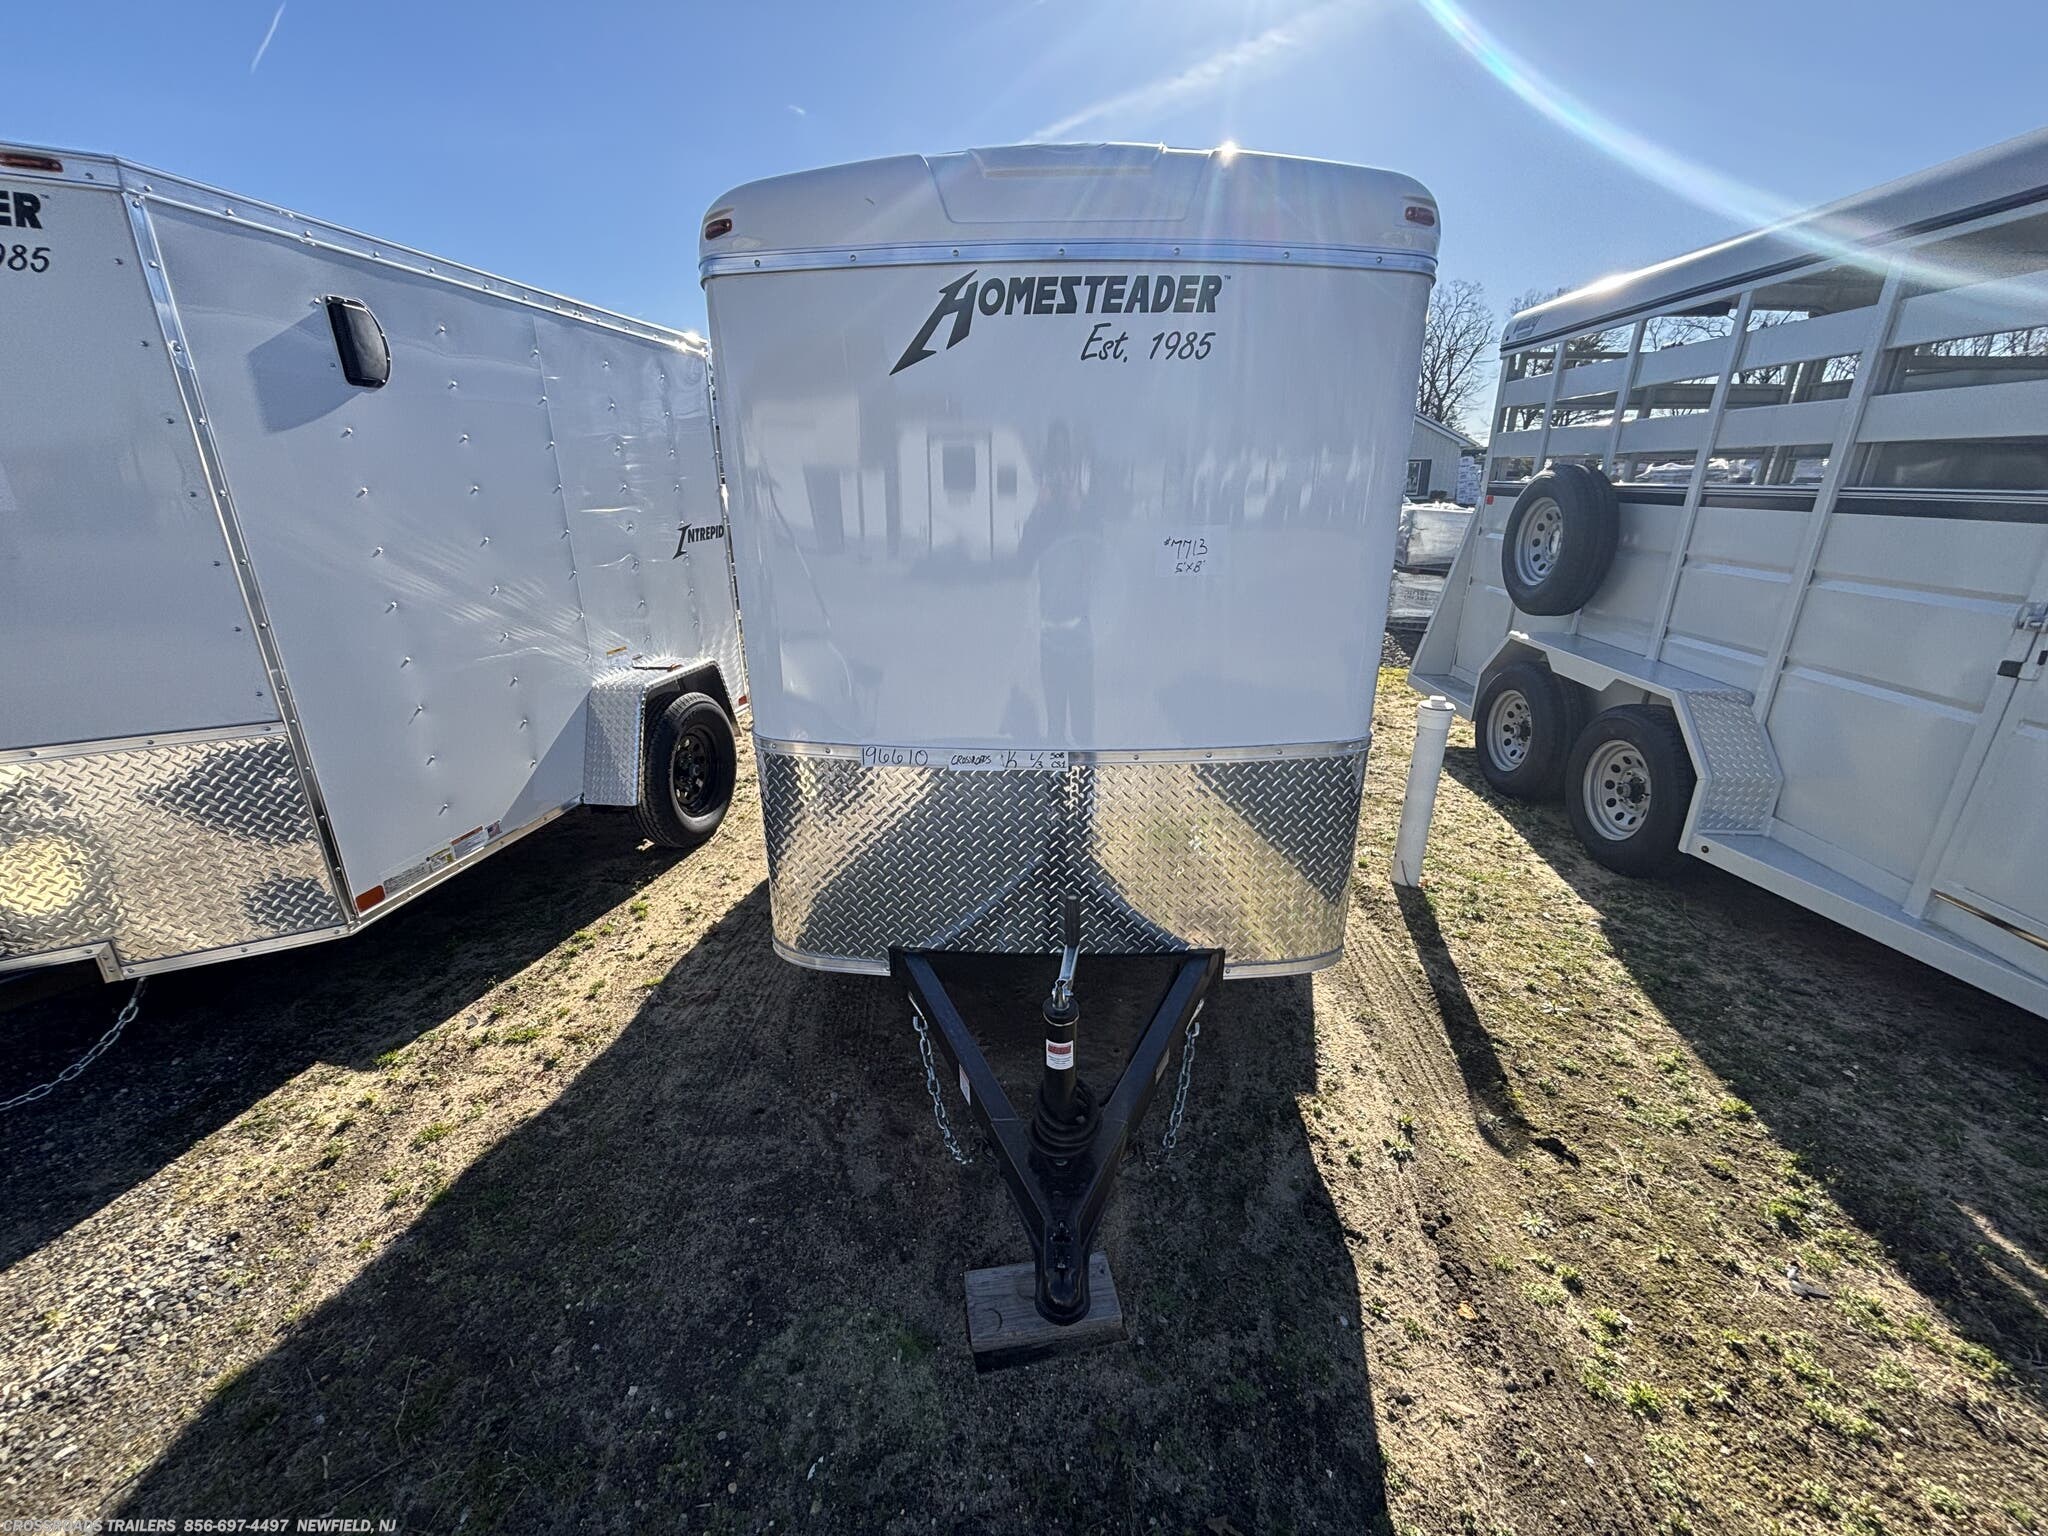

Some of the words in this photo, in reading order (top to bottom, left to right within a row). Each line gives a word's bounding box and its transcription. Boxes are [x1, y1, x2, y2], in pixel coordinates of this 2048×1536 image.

[889, 269, 1223, 376] HOMESTEADER
[1080, 322, 1129, 363] Est.
[1149, 331, 1217, 361] 1985
[672, 523, 725, 560] INTREPID
[862, 746, 929, 767] 196610
